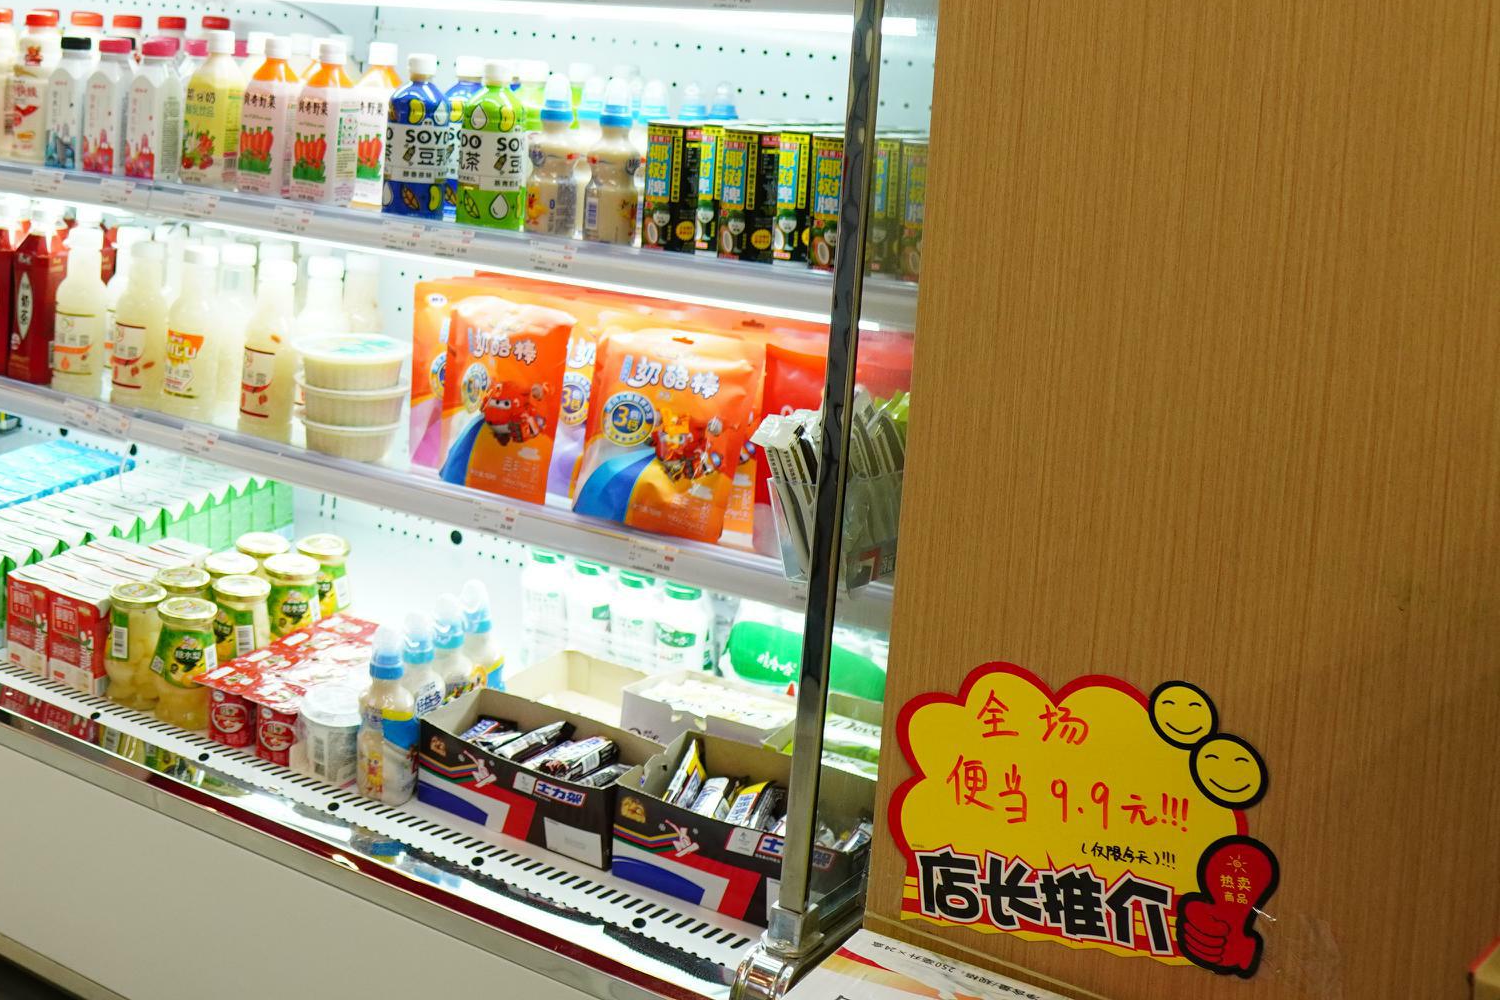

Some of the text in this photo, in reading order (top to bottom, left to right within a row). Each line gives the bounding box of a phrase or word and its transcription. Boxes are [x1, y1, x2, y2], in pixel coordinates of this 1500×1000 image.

[626, 355, 720, 399] 奶酪棒
[977, 689, 1090, 746] 全场
[537, 781, 584, 805] 士力架
